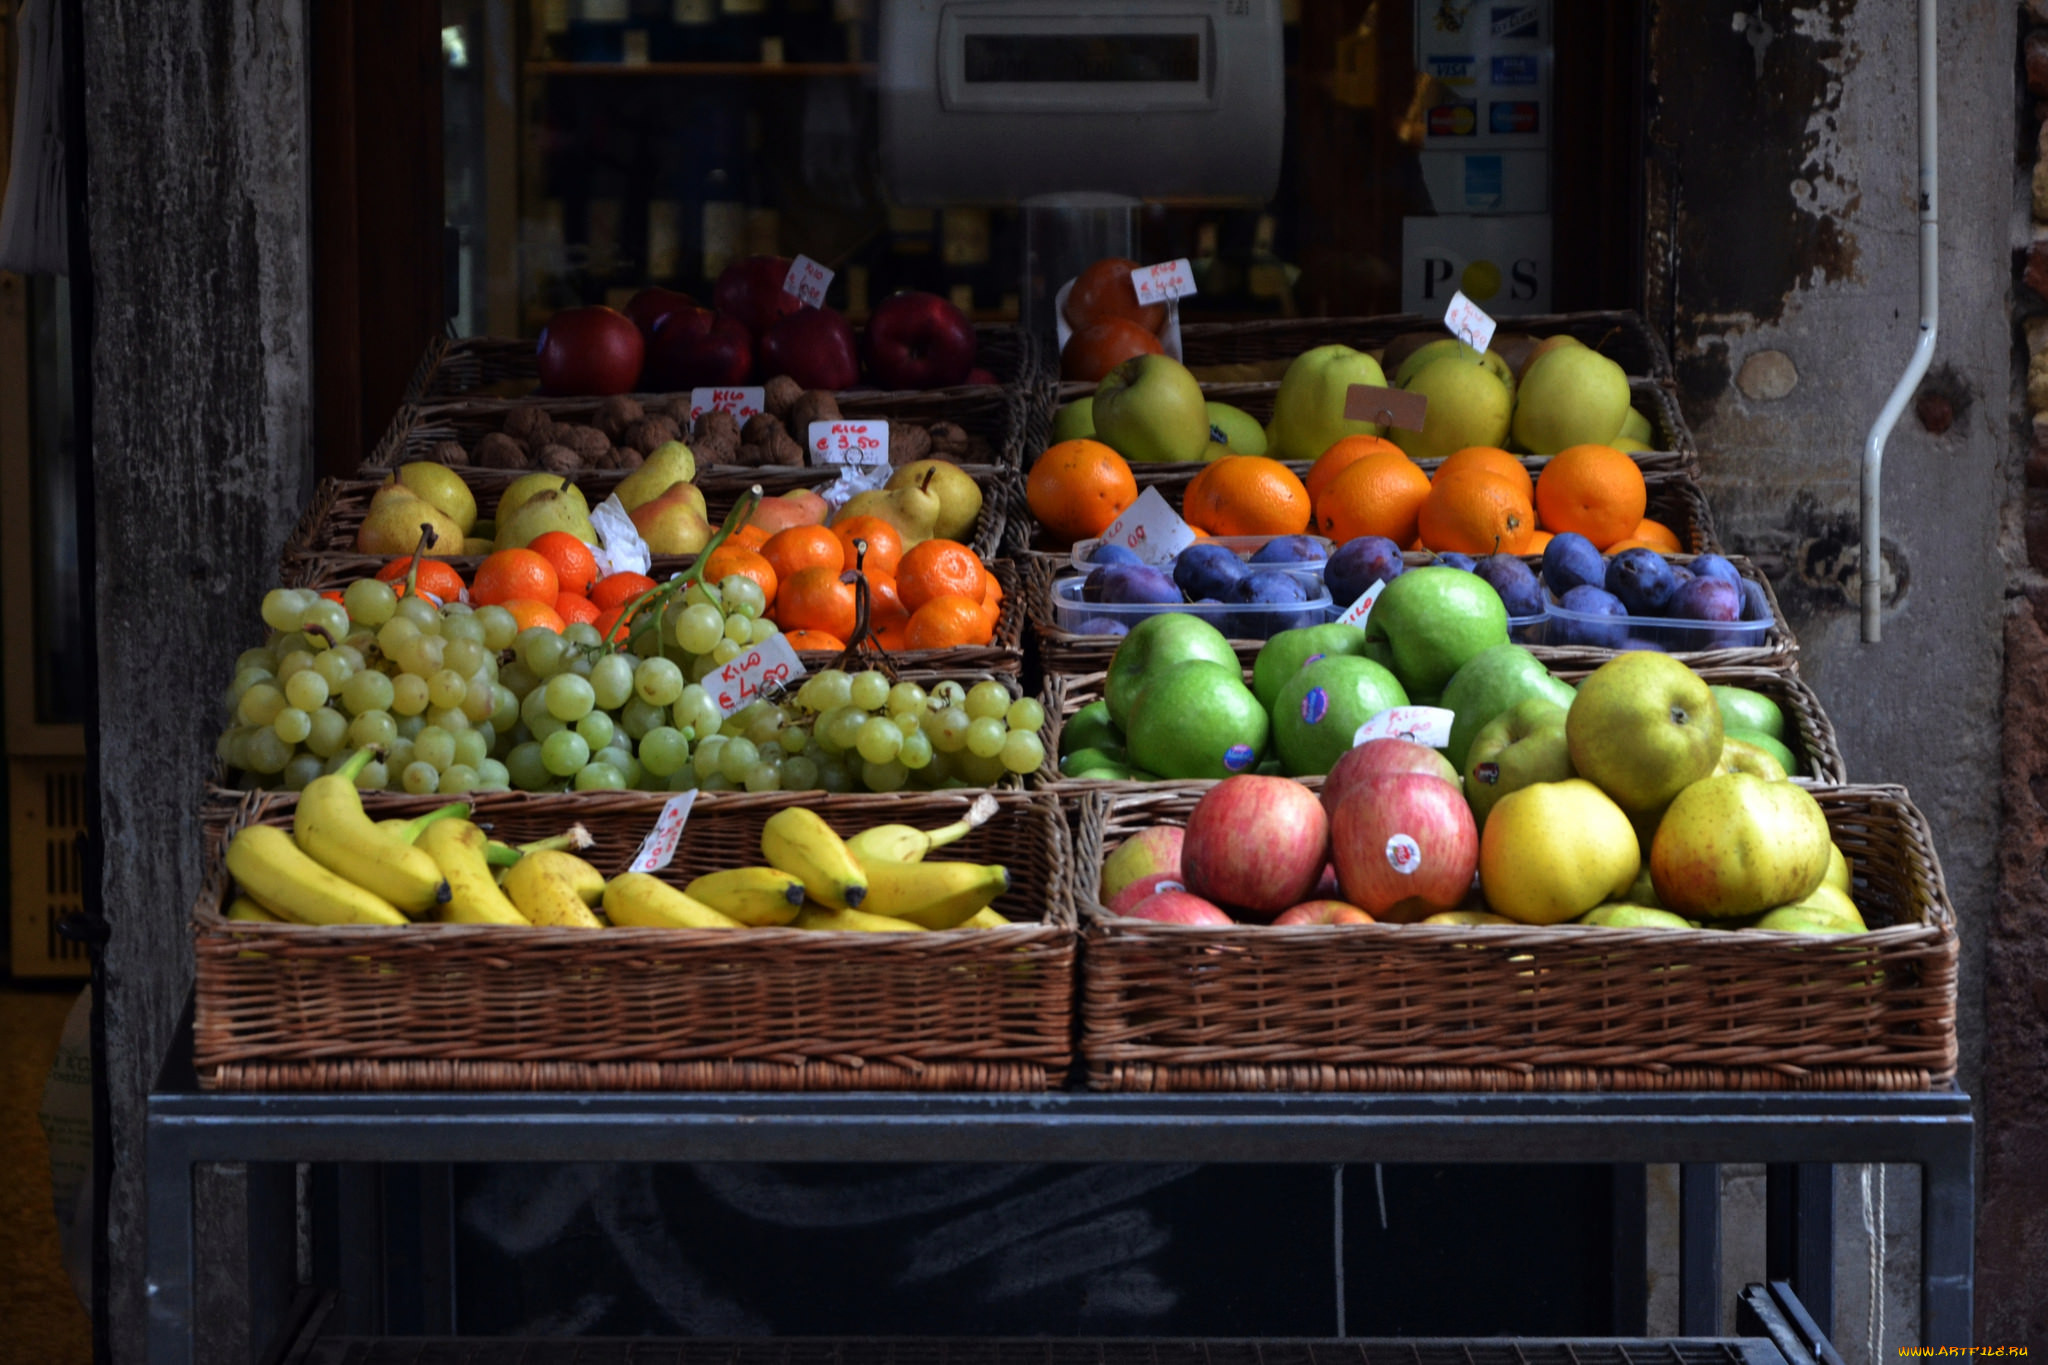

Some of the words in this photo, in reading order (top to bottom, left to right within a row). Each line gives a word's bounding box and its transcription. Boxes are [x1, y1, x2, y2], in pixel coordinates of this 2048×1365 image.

[1437, 63, 1467, 77] VISA
[713, 389, 744, 403] KILO
[832, 424, 867, 435] KILO
[721, 652, 760, 682] KILO
[719, 692, 735, 709] €
